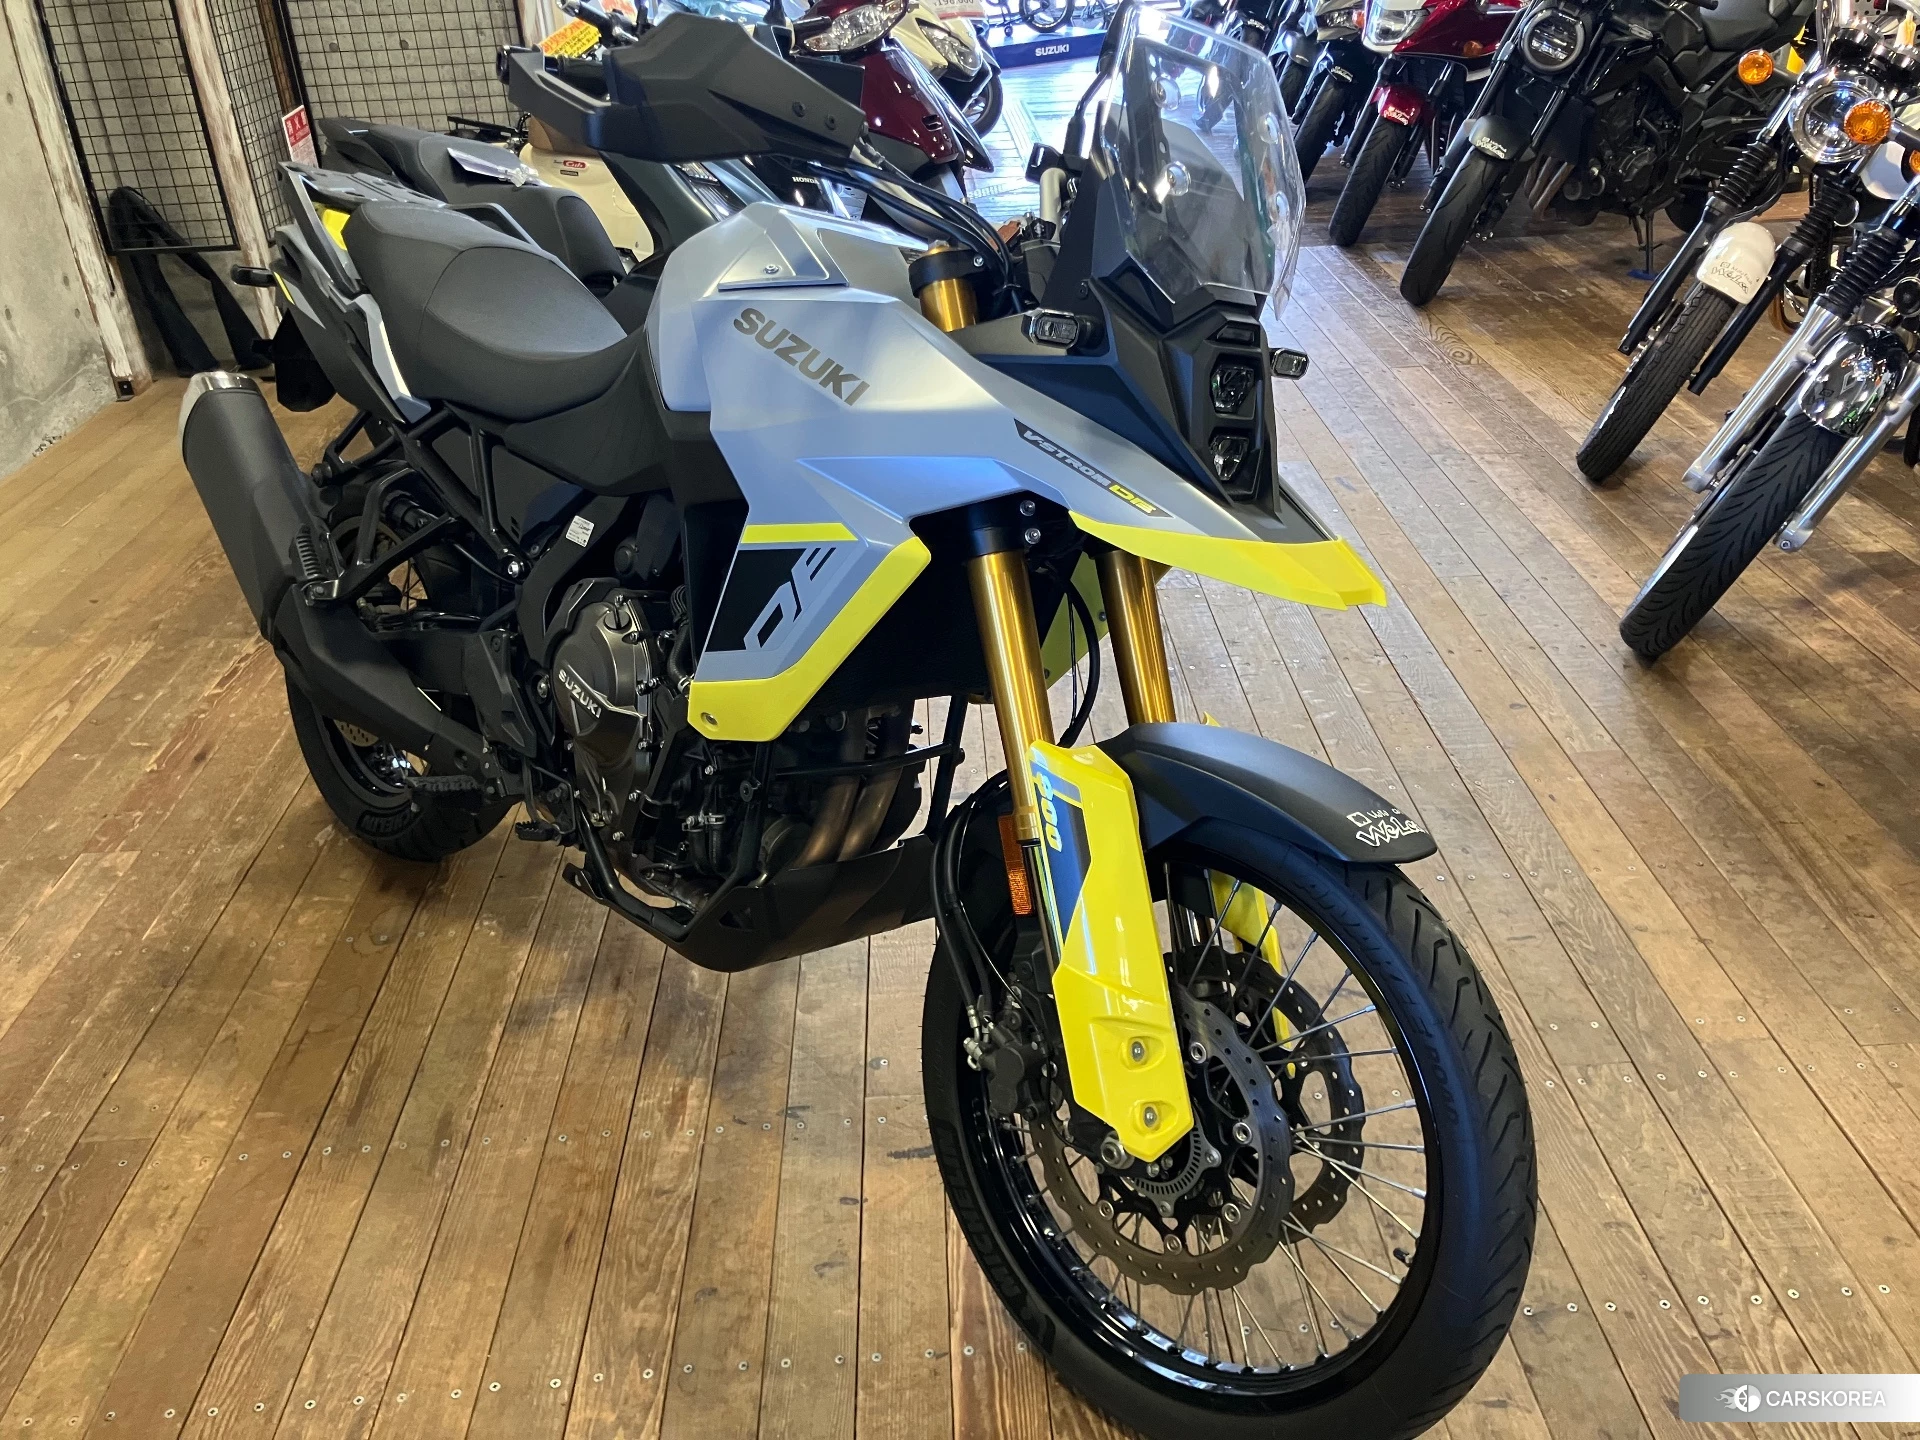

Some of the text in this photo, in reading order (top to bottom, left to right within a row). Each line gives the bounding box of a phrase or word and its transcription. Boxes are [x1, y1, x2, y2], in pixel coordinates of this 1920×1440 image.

[1035, 44, 1069, 57] SUZUKI
[792, 176, 819, 184] HONDA
[733, 307, 870, 407] SUZUKI
[1023, 430, 1157, 514] V-STROM DE
[558, 668, 602, 719] SUZUKI
[1031, 769, 1063, 853] 800
[935, 1125, 1021, 1298] MICHELIN
